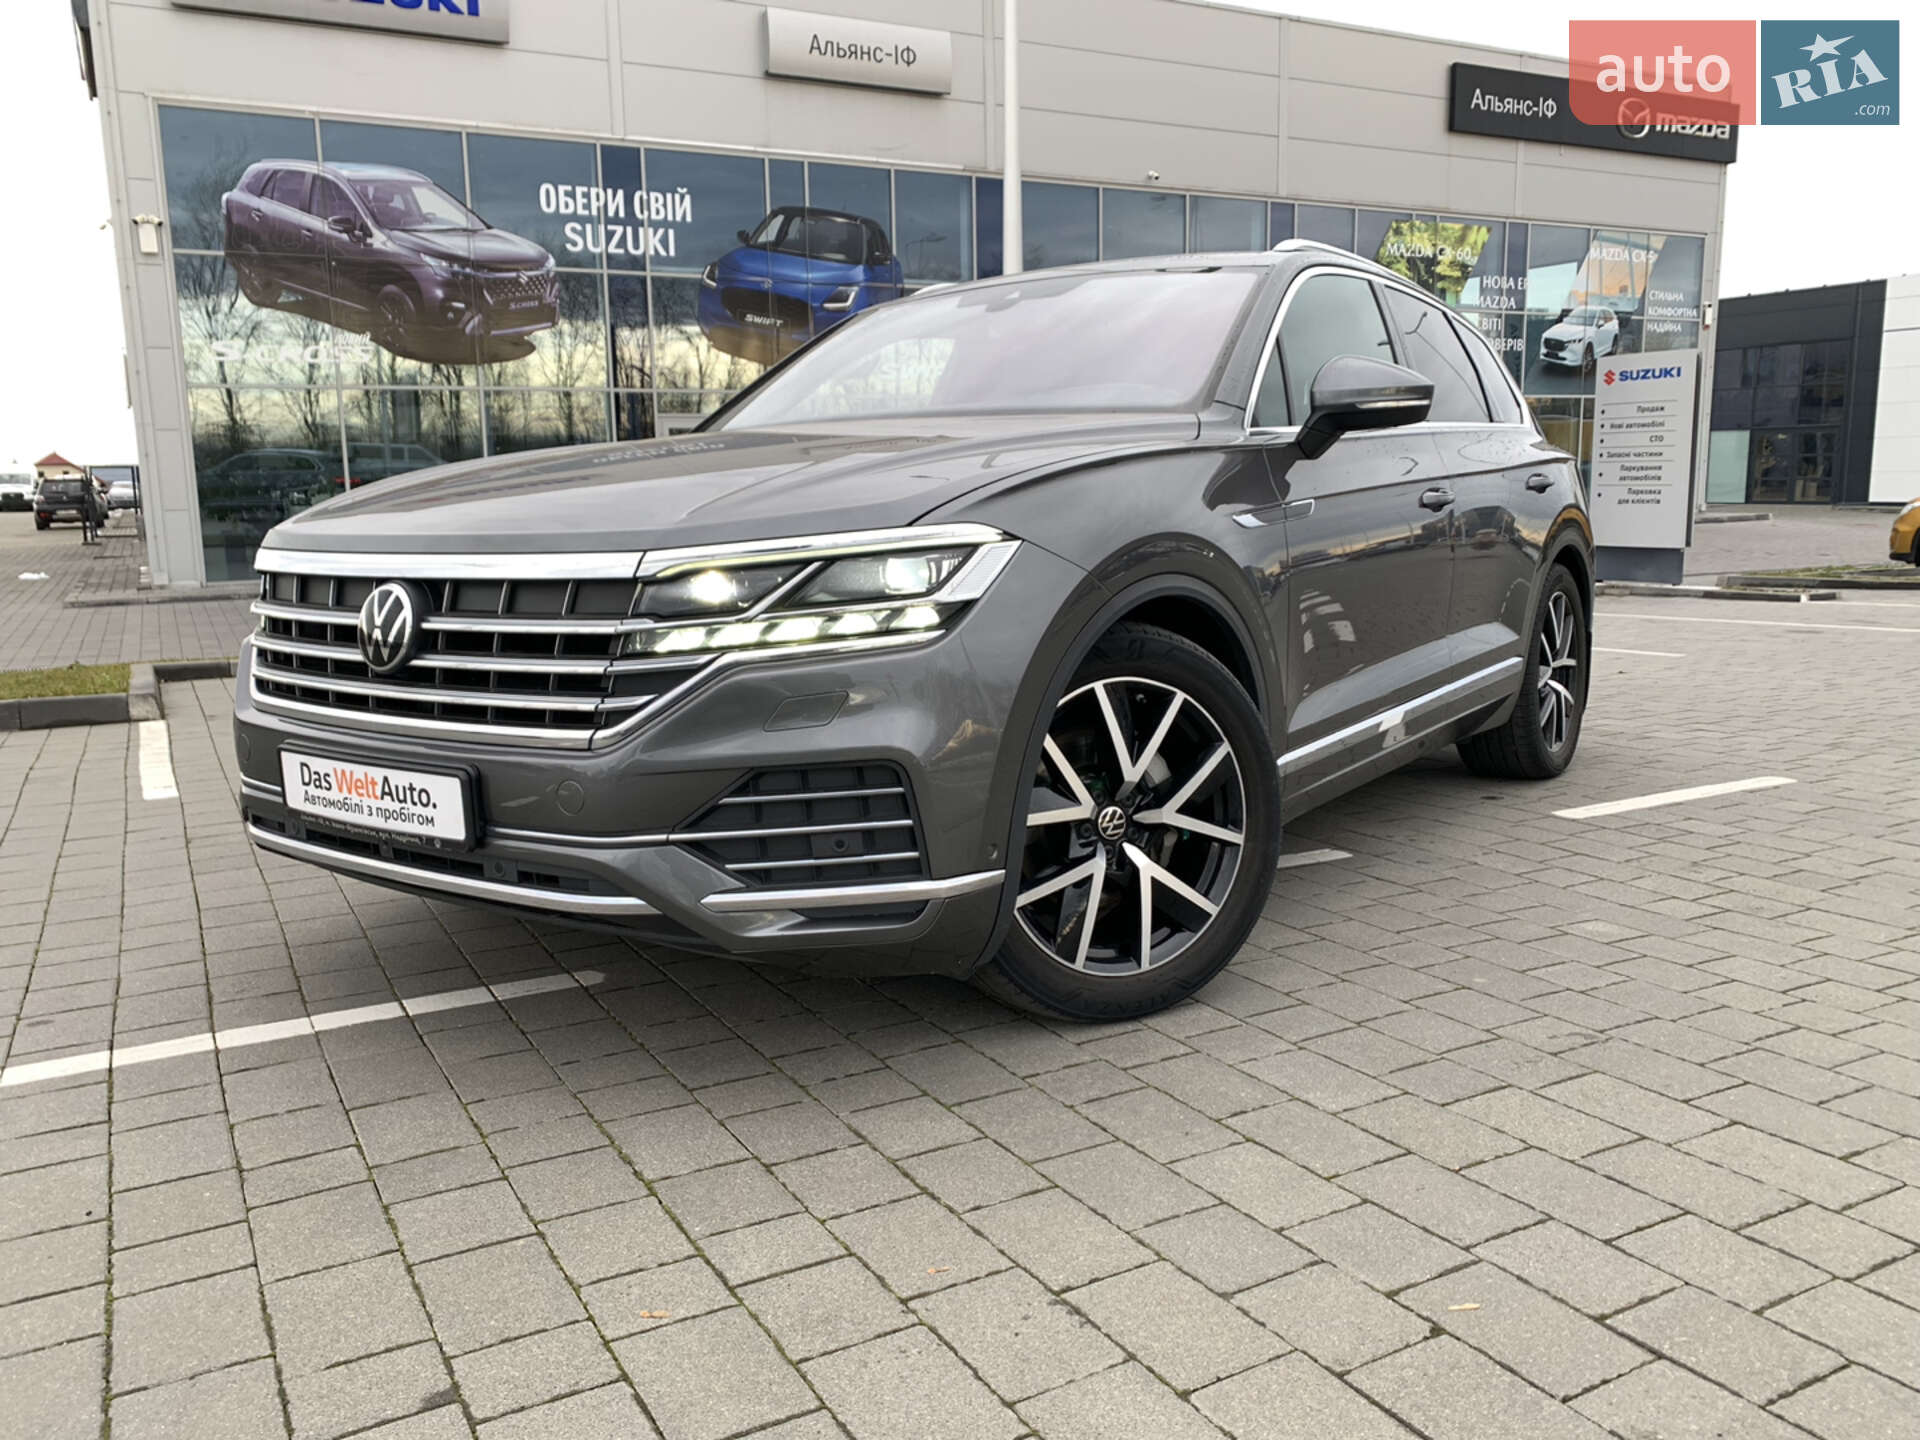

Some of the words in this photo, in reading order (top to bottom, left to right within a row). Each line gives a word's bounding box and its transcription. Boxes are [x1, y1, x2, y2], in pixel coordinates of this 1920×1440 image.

[809, 33, 917, 67] Альянс-ІФ
[1471, 88, 1557, 118] Альянс-ІФ
[539, 182, 625, 218] ОБЕРИ
[633, 187, 692, 223] СВІЙ
[564, 222, 675, 257] SUZUKI
[1385, 243, 1433, 258] MAZDA
[1482, 275, 1515, 290] НОВА
[1618, 366, 1682, 381] SUZUKI
[1649, 435, 1664, 443] СТО
[300, 762, 332, 791] Das
[304, 790, 364, 815] Автомобілі
[366, 804, 373, 816] з
[376, 806, 435, 828] пробігом
